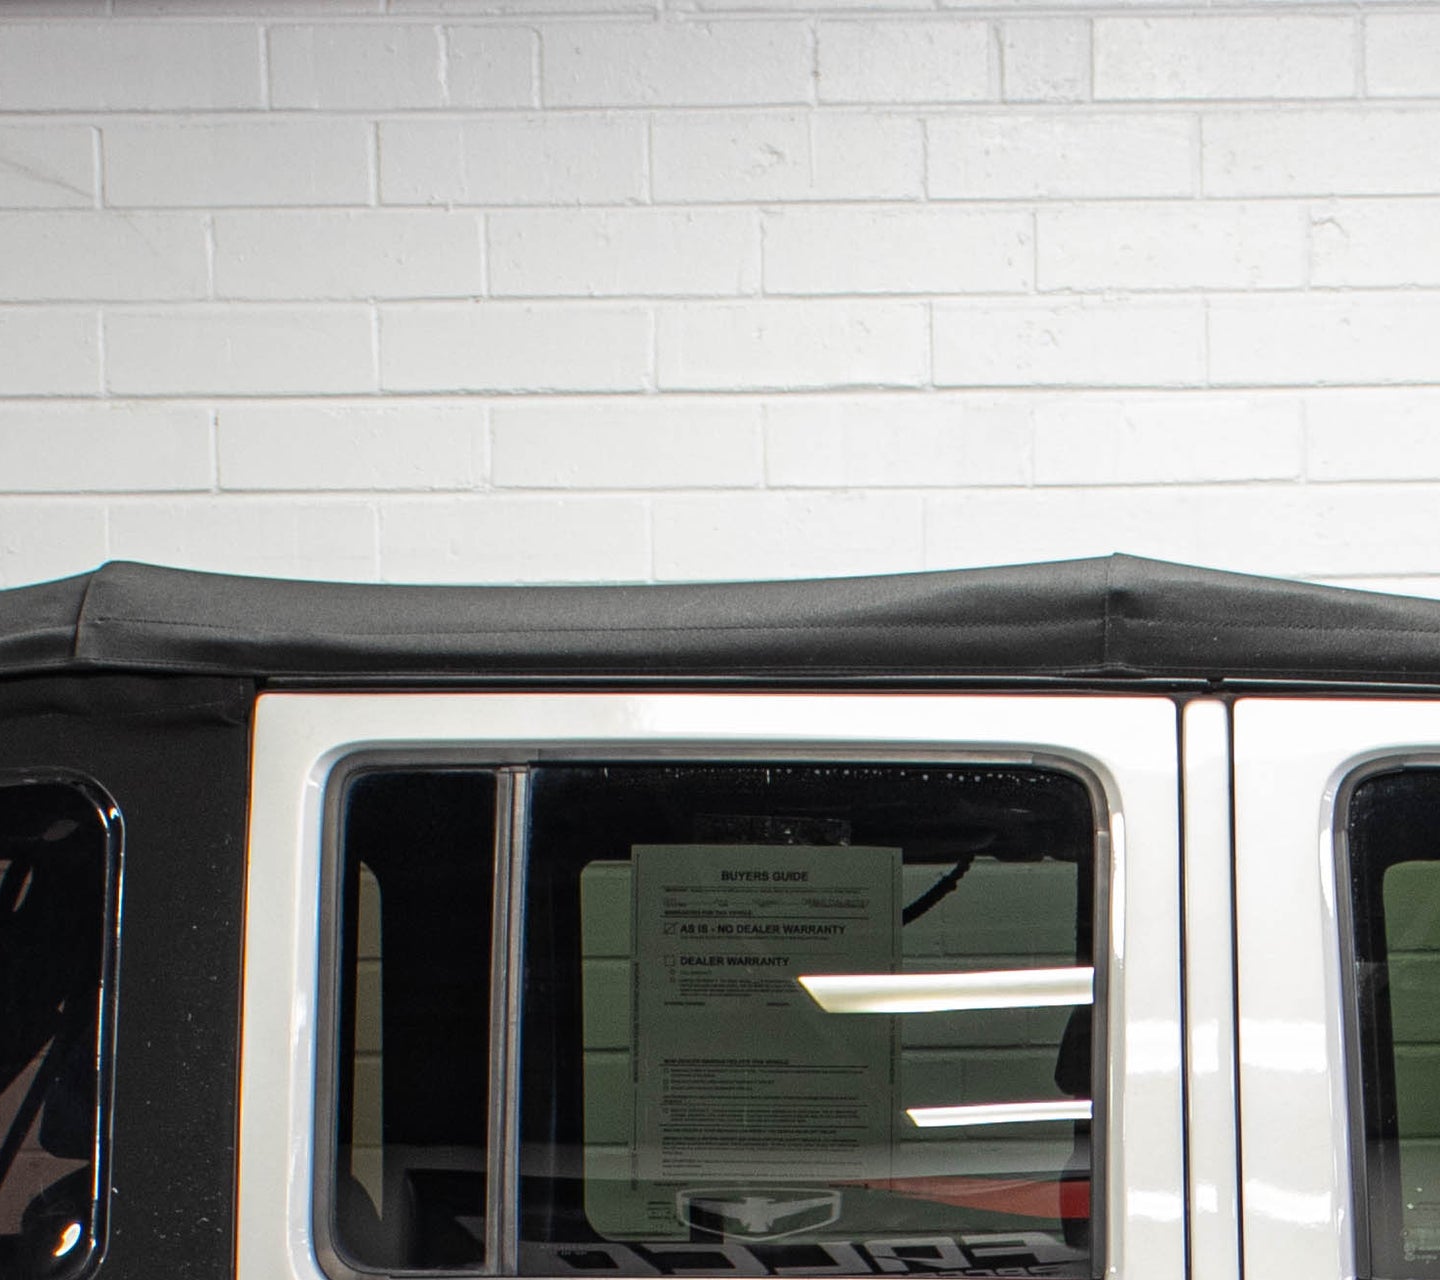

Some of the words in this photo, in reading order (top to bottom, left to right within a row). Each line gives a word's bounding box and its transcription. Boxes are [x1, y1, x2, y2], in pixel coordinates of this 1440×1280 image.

[721, 870, 769, 882] BUYERS
[772, 871, 809, 883] GUIDE
[681, 924, 696, 935] AS
[698, 924, 710, 935] IS
[718, 924, 735, 935] NO
[736, 924, 780, 935] DEALER
[783, 924, 847, 936] WARRANTY
[680, 956, 725, 967] DEALER
[726, 956, 790, 968] WARRANTY
